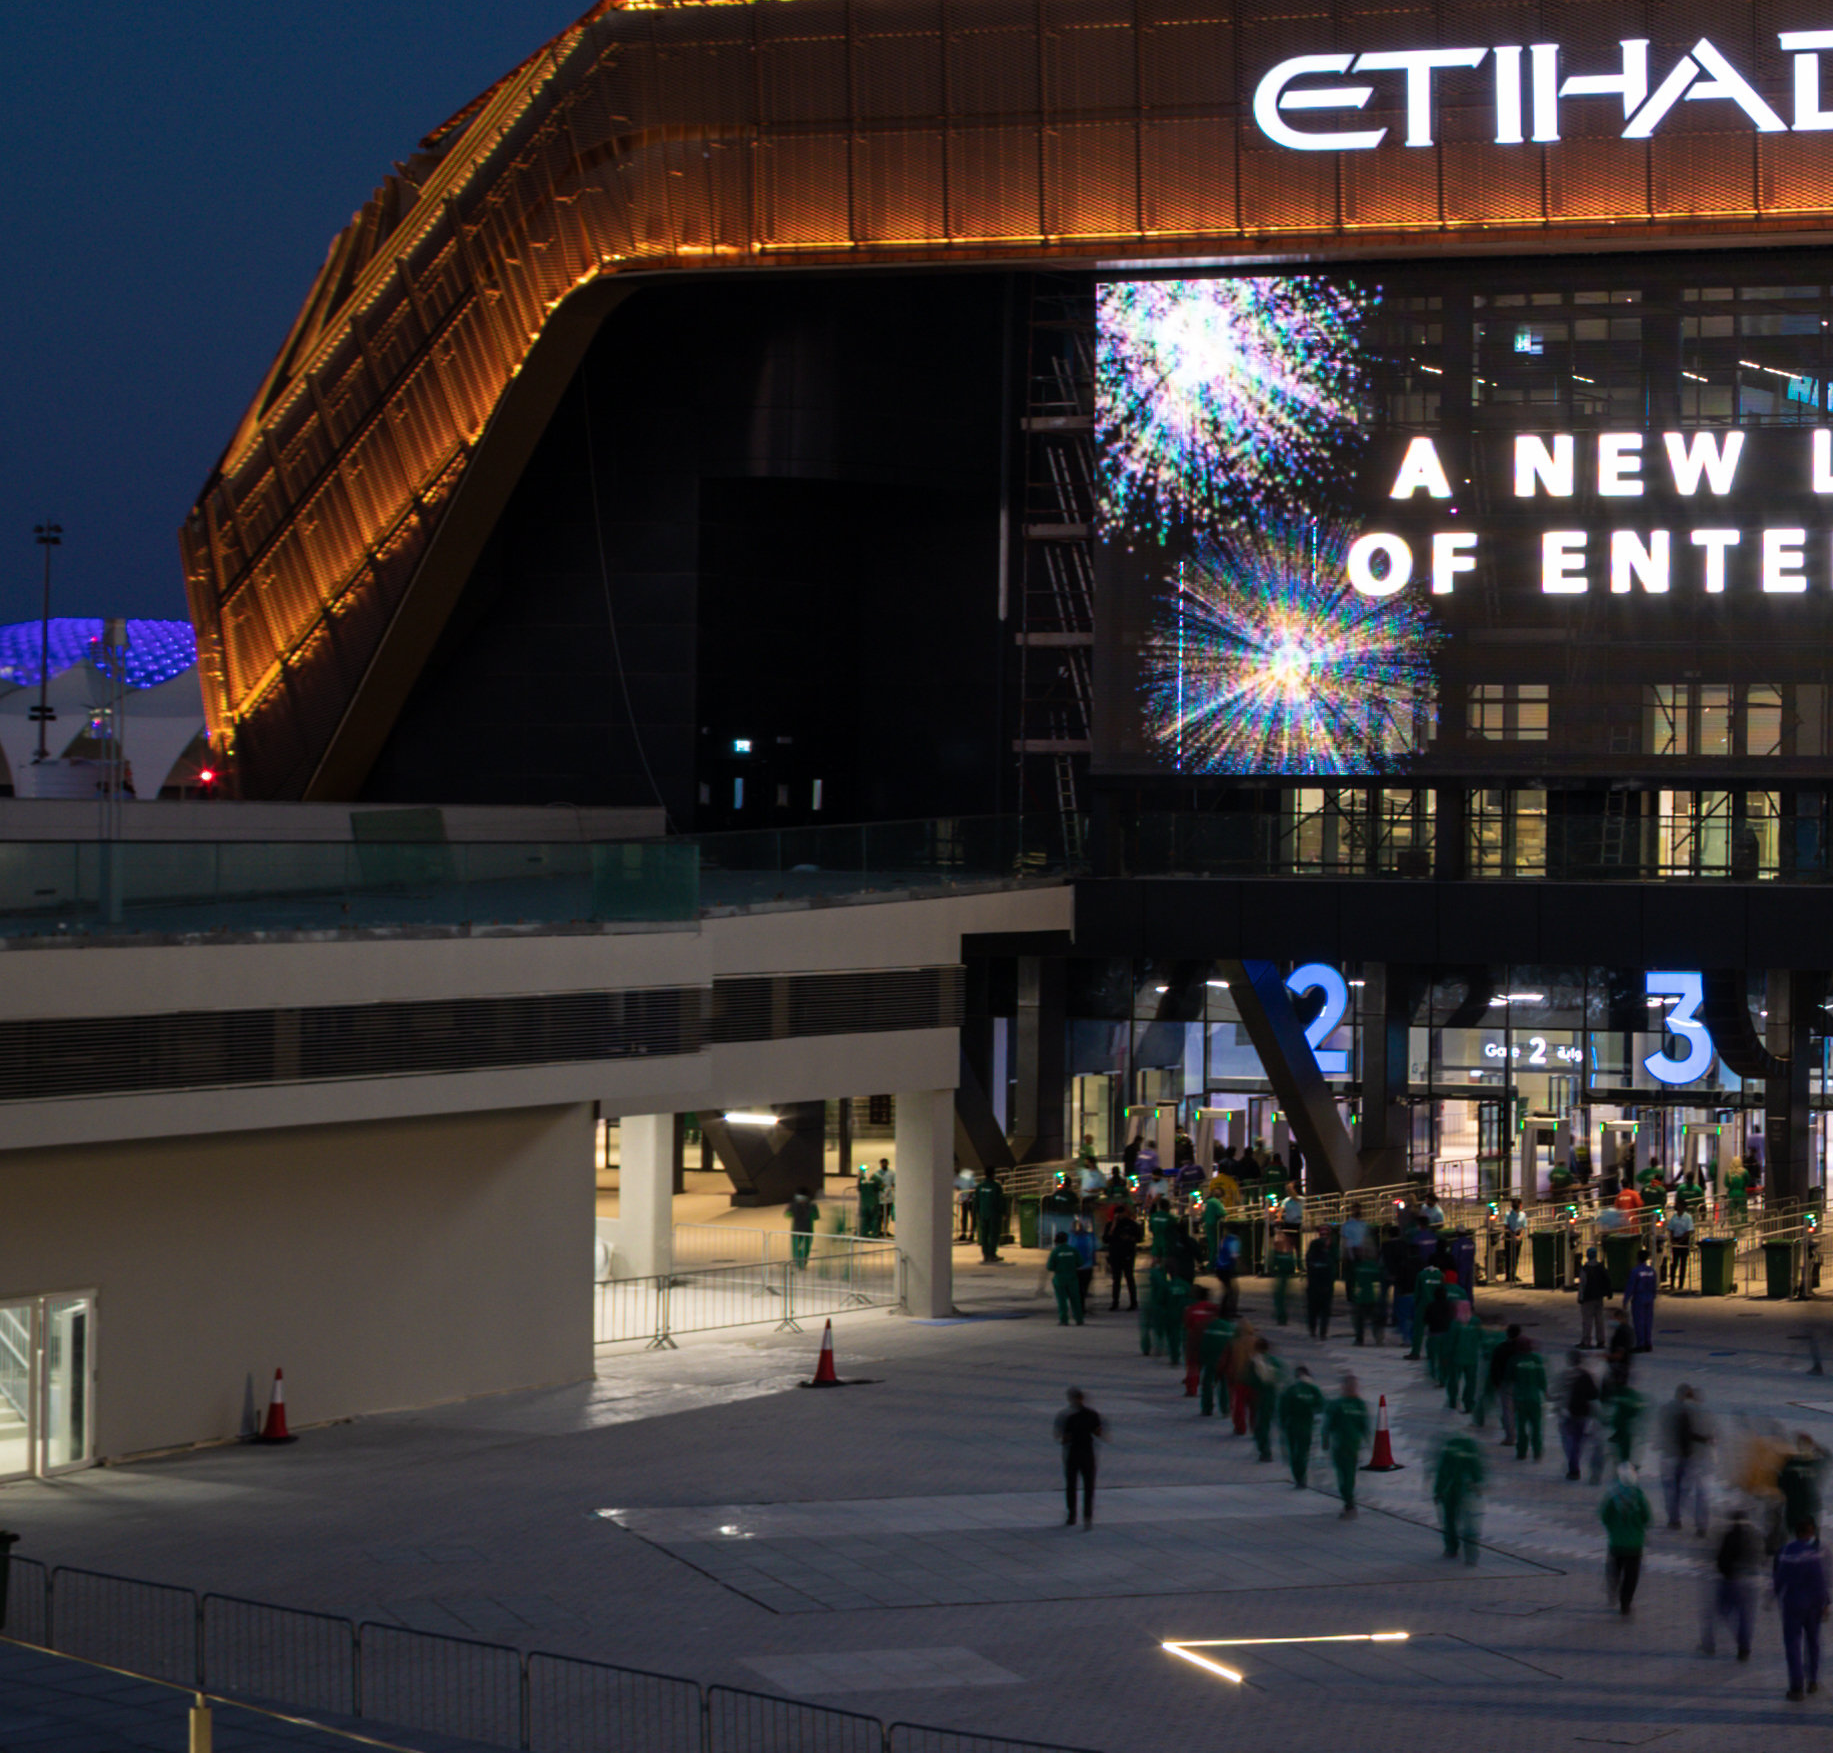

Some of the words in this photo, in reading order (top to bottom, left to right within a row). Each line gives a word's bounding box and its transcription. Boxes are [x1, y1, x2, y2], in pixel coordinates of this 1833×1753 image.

[1391, 437, 1452, 499] A
[1514, 431, 1746, 497] NEW
[1347, 531, 1479, 597] OF
[1284, 962, 1349, 1073] 2
[1484, 1042, 1521, 1059] Gae
[1529, 1036, 1547, 1064] 2
[1642, 970, 1715, 1085] 3
